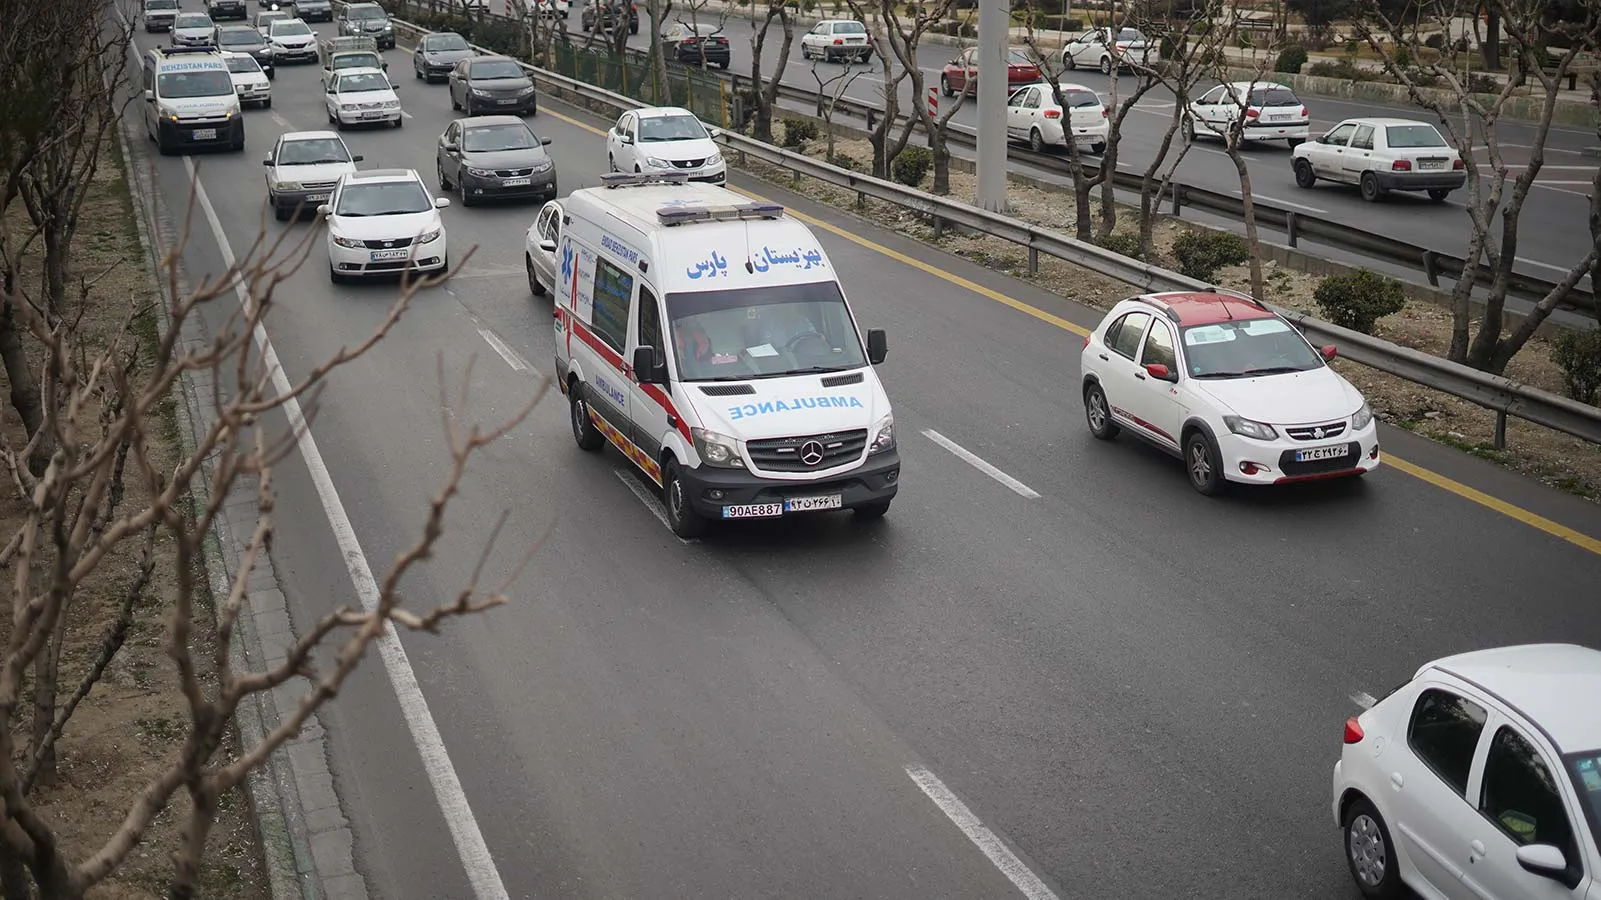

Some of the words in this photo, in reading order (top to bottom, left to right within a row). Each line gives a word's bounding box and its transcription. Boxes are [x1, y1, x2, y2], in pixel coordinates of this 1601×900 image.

[204, 62, 223, 70] PARS
[686, 250, 728, 280] پارس
[752, 246, 825, 273] بهزیستان
[729, 504, 781, 517] 90AE887
